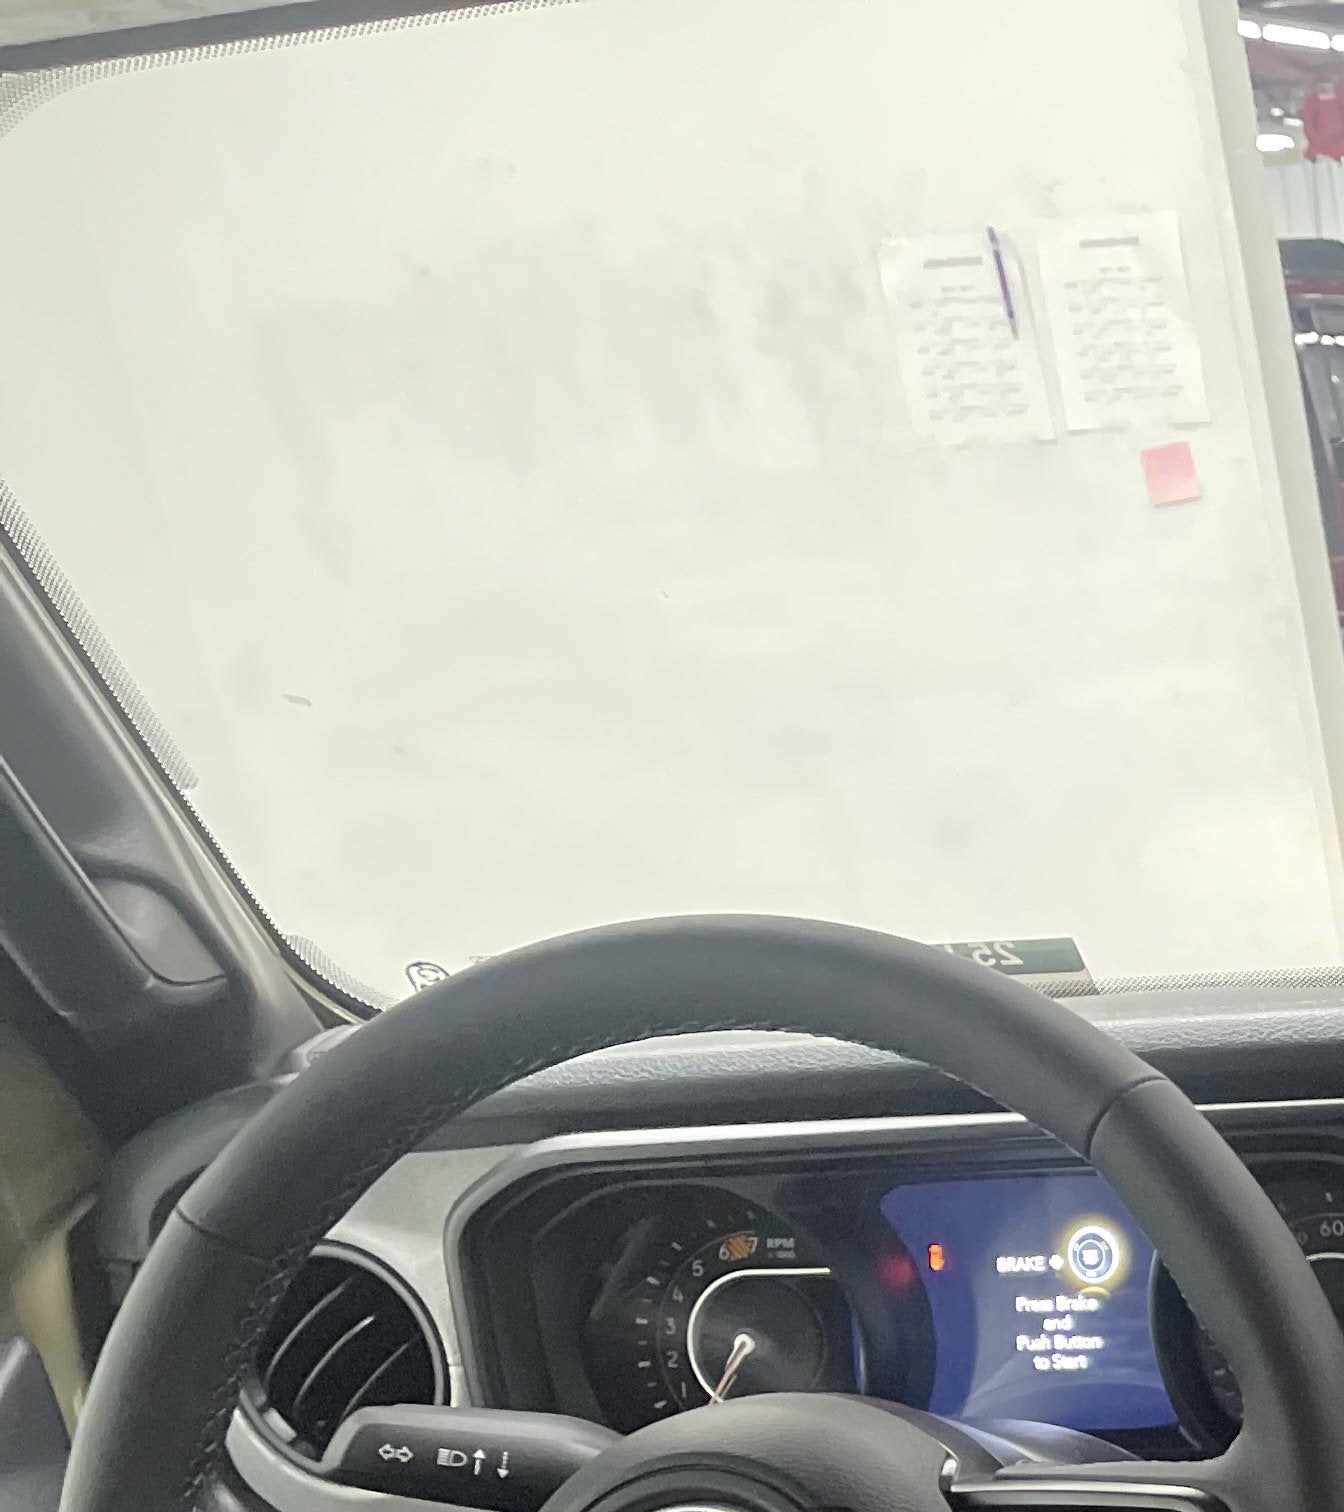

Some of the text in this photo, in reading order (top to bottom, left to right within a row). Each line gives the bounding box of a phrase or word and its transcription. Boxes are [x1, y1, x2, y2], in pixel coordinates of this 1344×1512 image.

[1319, 1220, 1344, 1238] 60
[691, 1260, 704, 1278] 5
[996, 1256, 1046, 1273] BRAKE
[1015, 1295, 1100, 1313] Press Brake
[664, 1318, 677, 1335] 3
[1043, 1314, 1075, 1332] and
[1016, 1334, 1105, 1352] Push Button
[666, 1352, 679, 1369] 2
[1032, 1353, 1089, 1371] to Start
